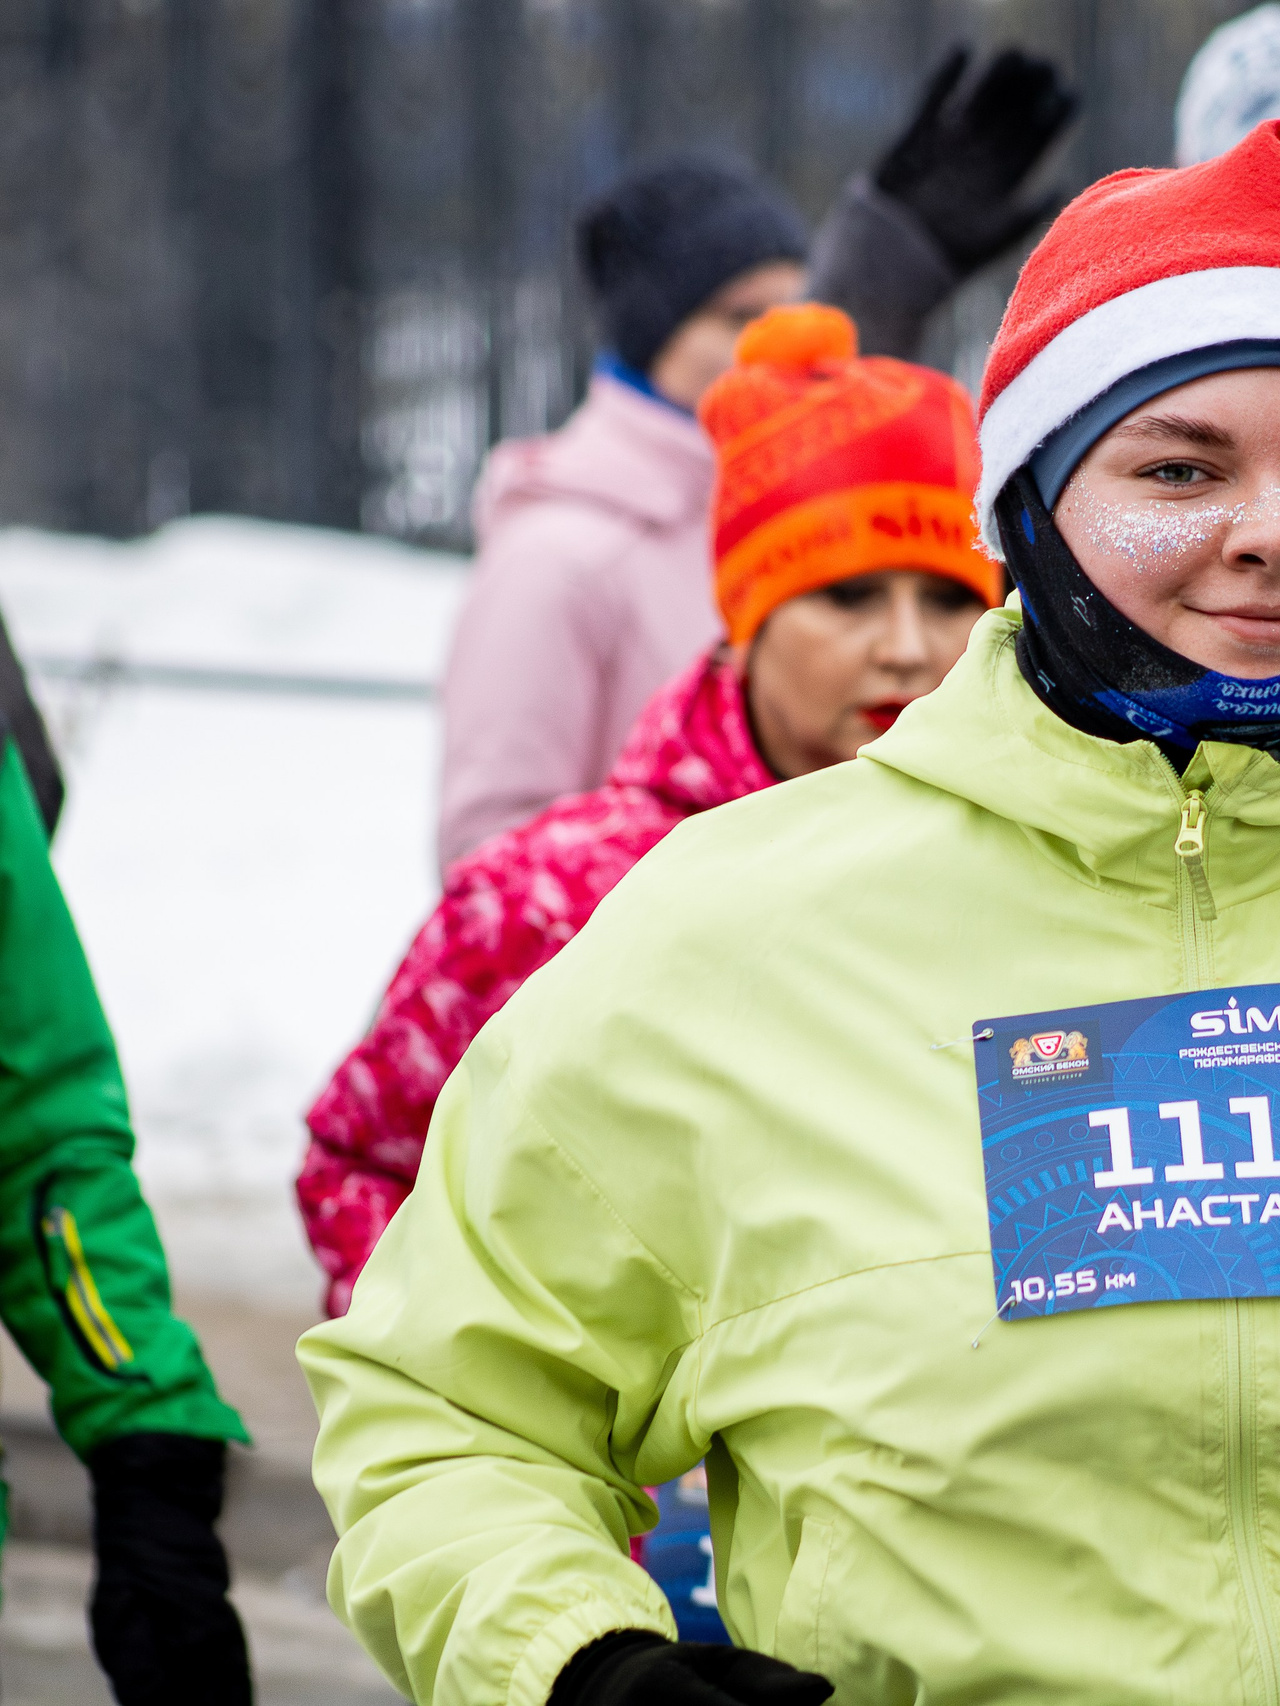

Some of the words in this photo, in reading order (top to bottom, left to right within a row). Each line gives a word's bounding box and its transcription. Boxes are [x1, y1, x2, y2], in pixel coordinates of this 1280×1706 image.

[1012, 1064, 1055, 1076] ОМСКИЙ
[1056, 1059, 1089, 1070] БЕКОН
[1010, 1269, 1097, 1303] 10,55
